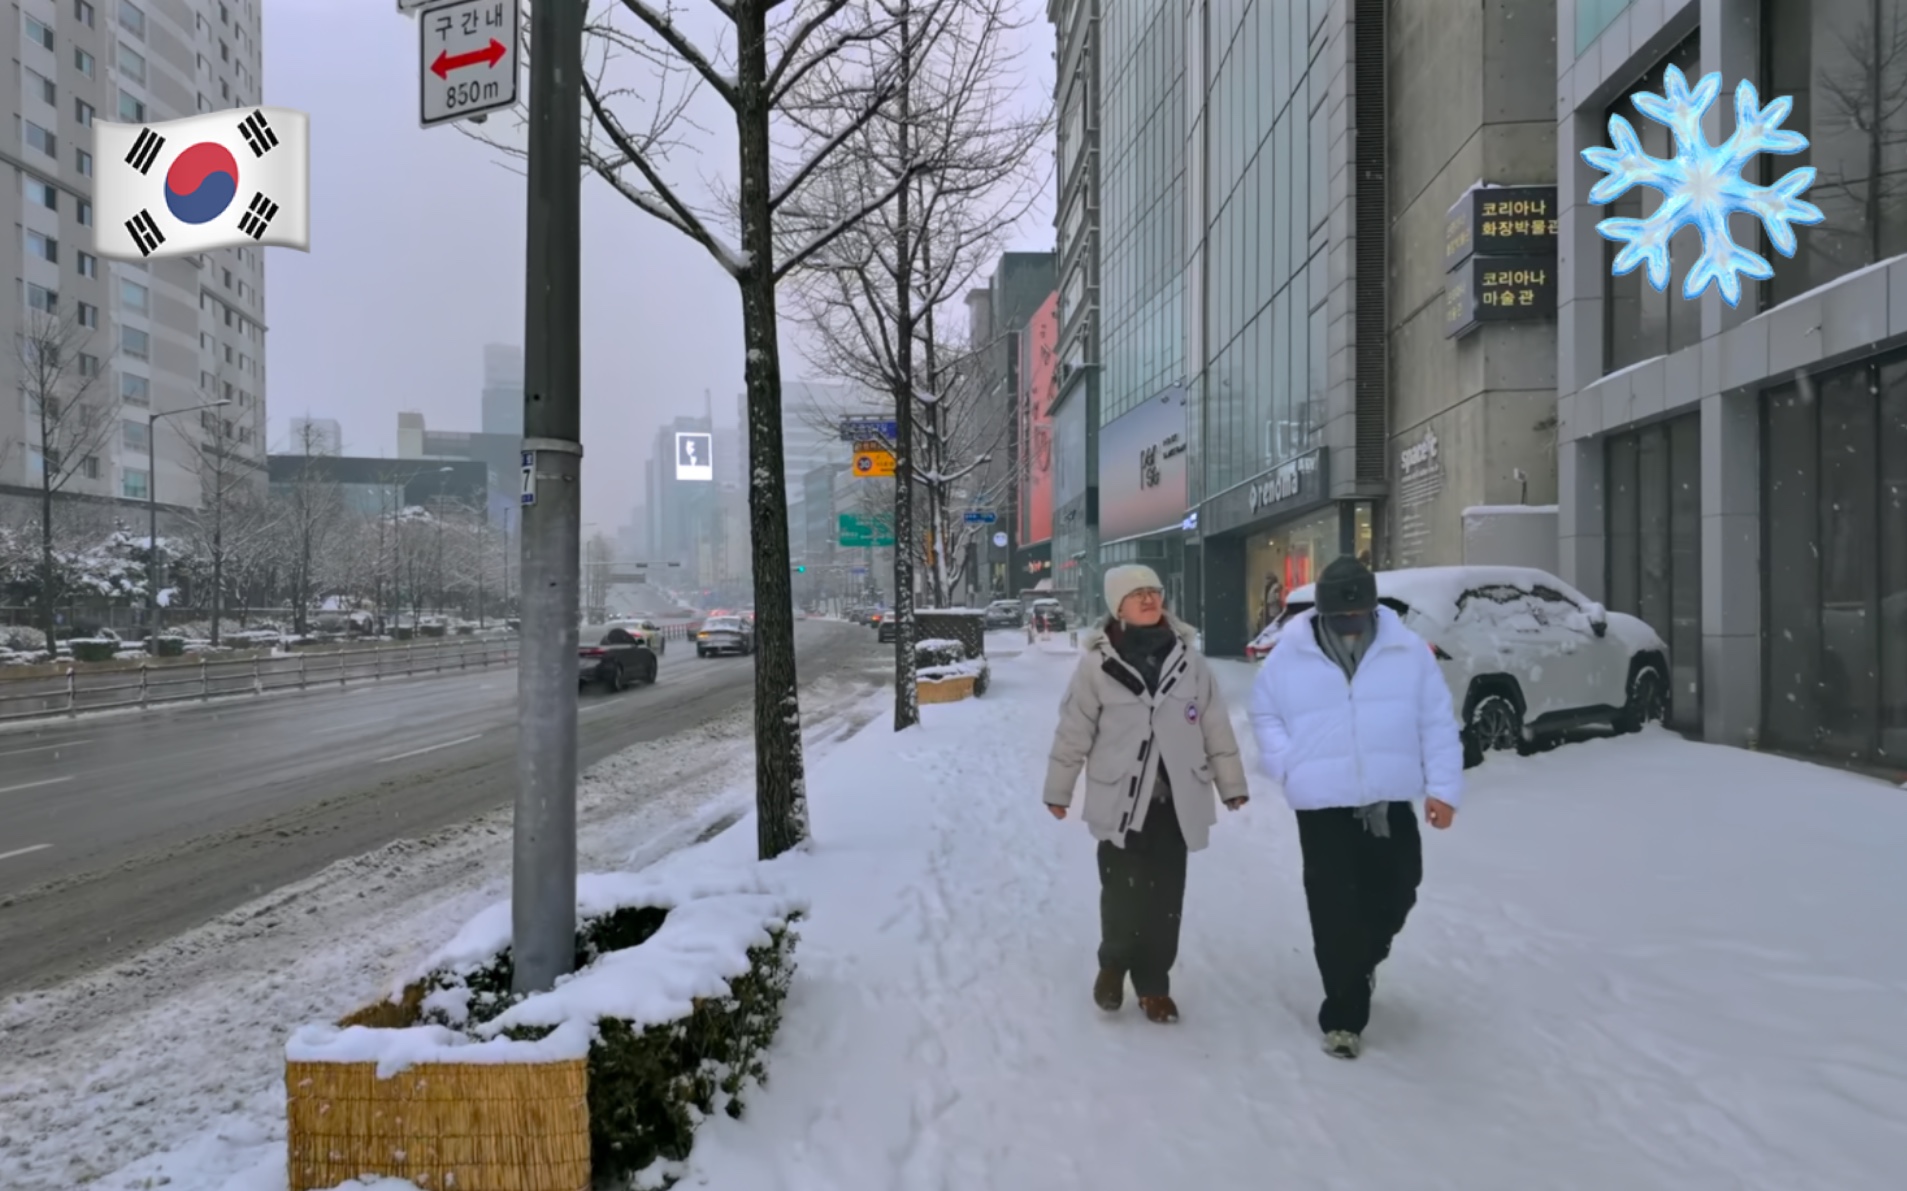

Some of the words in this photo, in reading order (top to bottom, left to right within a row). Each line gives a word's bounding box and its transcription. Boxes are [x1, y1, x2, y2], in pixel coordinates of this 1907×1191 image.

[446, 81, 499, 109] 850m
[1482, 200, 1546, 216] 코리아나
[1482, 270, 1545, 286] 코리아나
[523, 469, 531, 492] 7
